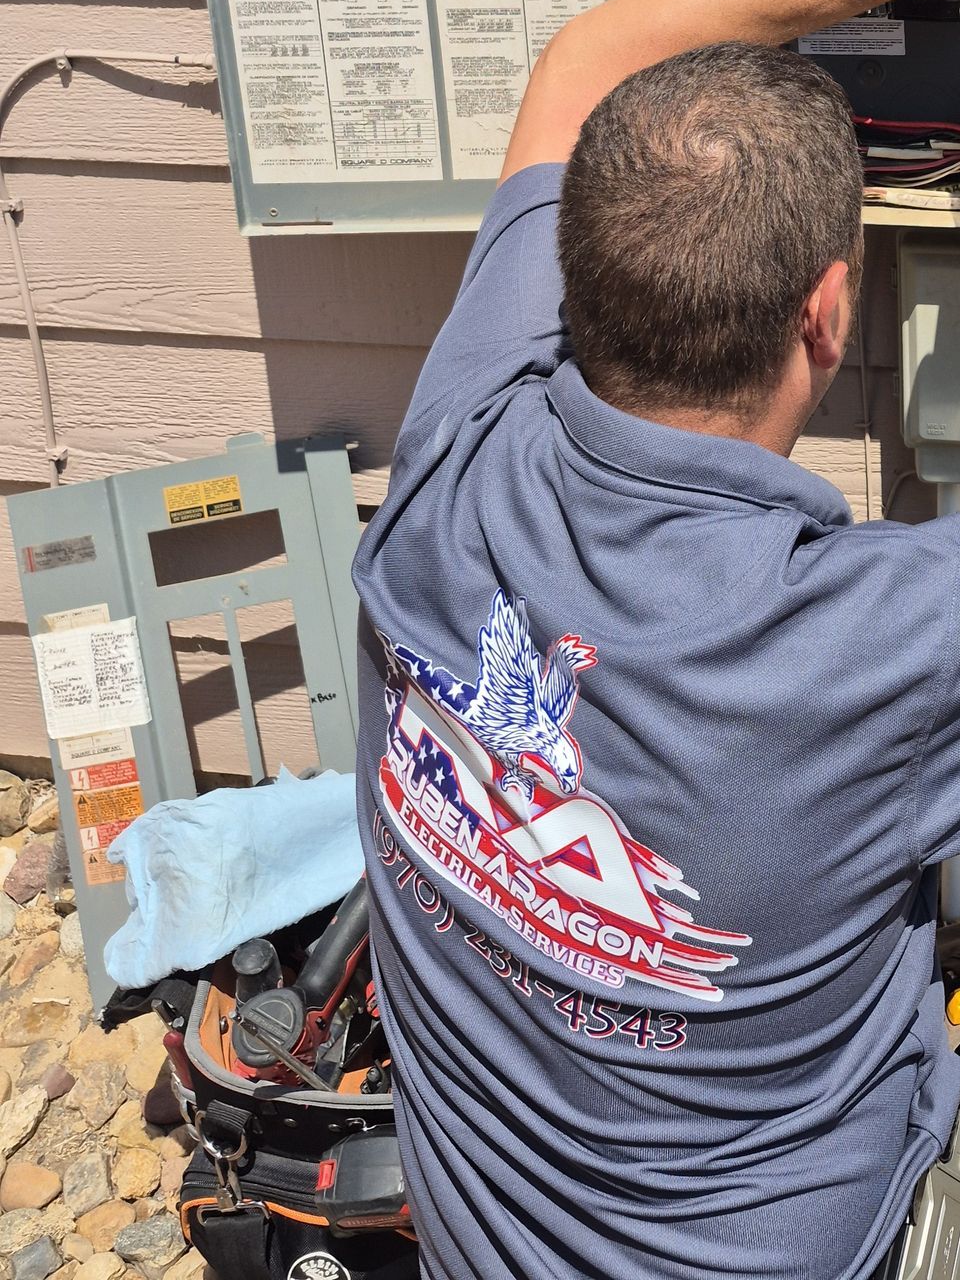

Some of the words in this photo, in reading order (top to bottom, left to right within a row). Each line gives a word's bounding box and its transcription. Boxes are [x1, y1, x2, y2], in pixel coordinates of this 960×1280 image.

[373, 808, 455, 933] (970)
[464, 923, 688, 1052] 231-4543
[387, 737, 483, 858] RUBEN
[483, 851, 664, 969] ARAGON
[398, 797, 505, 916] ELECTRICAL
[506, 904, 625, 986] SERVICES
[299, 1259, 339, 1275] KLEIN
